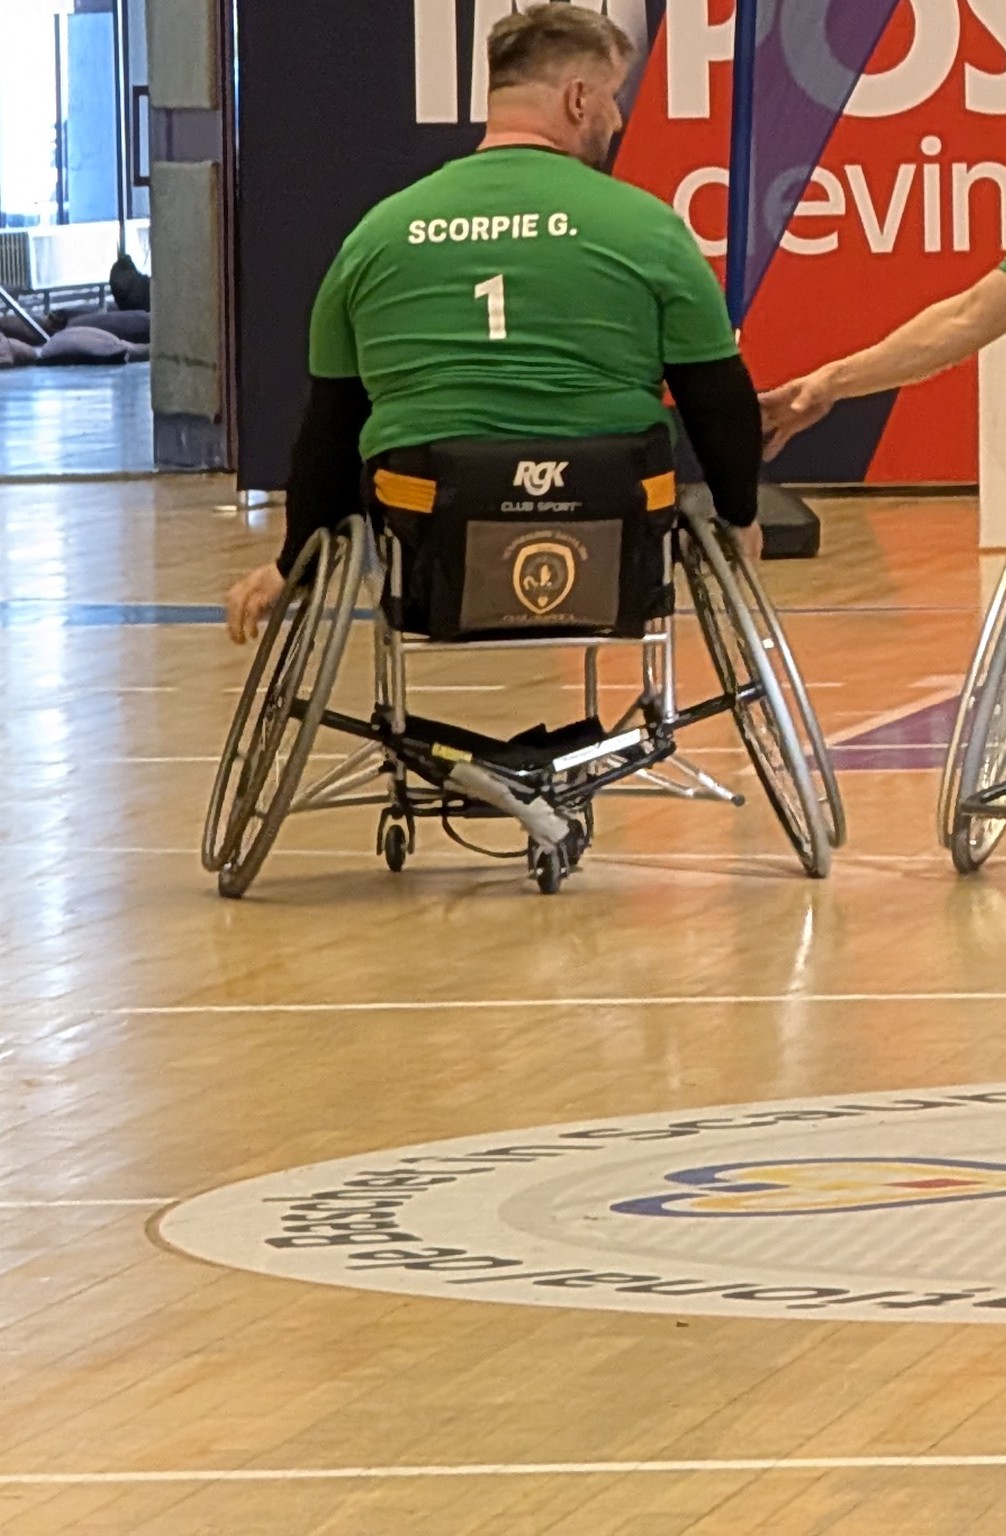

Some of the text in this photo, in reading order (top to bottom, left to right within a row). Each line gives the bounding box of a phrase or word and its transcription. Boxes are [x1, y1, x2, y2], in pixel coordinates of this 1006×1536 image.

[408, 212, 578, 244] SCORPIE G.
[474, 273, 508, 340] 1
[501, 501, 534, 512] CLUB
[261, 1166, 496, 1249] Baschet
